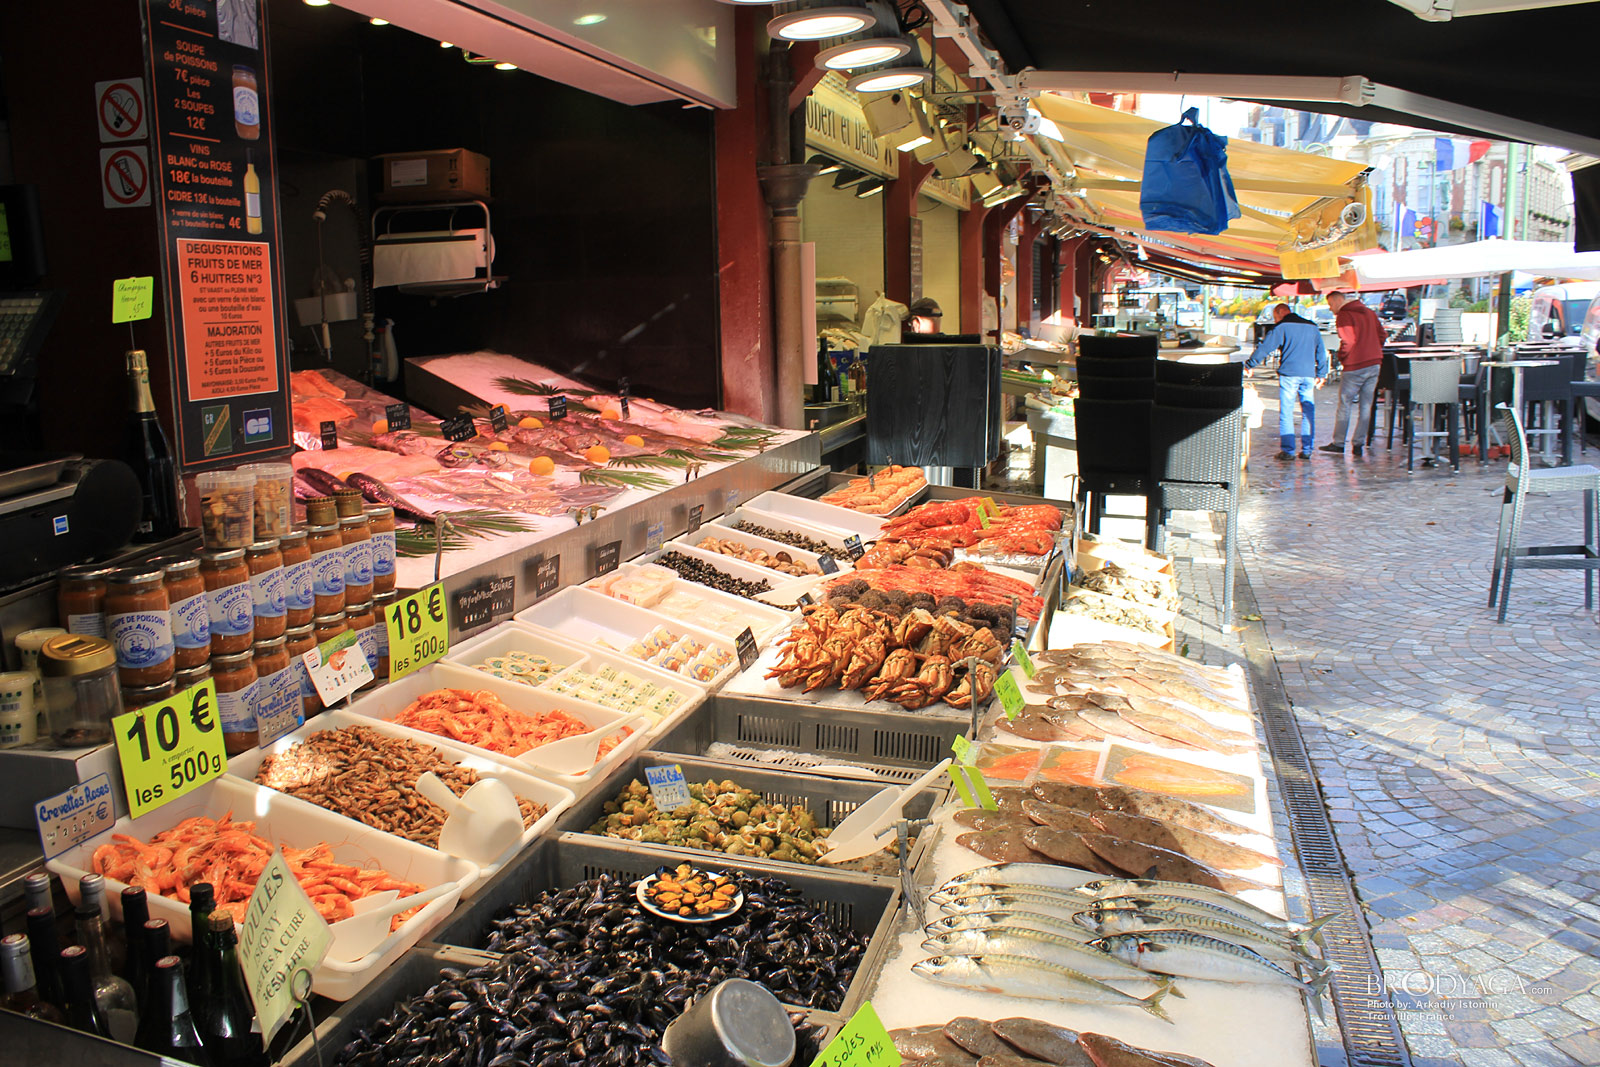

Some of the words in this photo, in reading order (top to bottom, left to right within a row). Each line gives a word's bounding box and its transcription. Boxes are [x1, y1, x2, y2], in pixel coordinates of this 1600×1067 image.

[176, 40, 205, 56] SOUPE
[164, 51, 174, 62] de
[176, 53, 218, 72] POISSONS
[174, 68, 188, 82] 7€
[187, 88, 200, 99] Les
[174, 98, 180, 108] 2
[181, 100, 214, 114] SOUPES
[187, 116, 206, 130] 12€
[806, 96, 836, 140] obert
[840, 116, 850, 146] et
[190, 144, 210, 156] VINS
[168, 154, 198, 168] BLANC
[198, 161, 208, 169] ou
[210, 160, 232, 172] ROSÉ
[170, 170, 190, 184] 18€
[192, 173, 198, 182] la
[200, 174, 232, 186] bouteille
[168, 190, 192, 202] CIDRE
[208, 196, 214, 204] la
[216, 198, 240, 206] bouteille
[228, 216, 241, 229] 4€
[186, 243, 262, 256] DEGUSTATIONS
[188, 258, 225, 269] FRUITS
[227, 259, 240, 269] DE
[242, 260, 262, 270] MER
[190, 270, 199, 283] 6
[201, 273, 244, 283] HUITRES
[246, 274, 262, 284] N°3
[207, 325, 262, 337] MAJORATION
[214, 588, 233, 604] SOUPE
[126, 615, 135, 623] DE
[136, 615, 165, 626] POISSONS
[392, 599, 421, 640] 18
[428, 587, 443, 622] €
[136, 624, 156, 636] Alain
[394, 657, 409, 673] les
[127, 706, 180, 762] 10
[190, 687, 215, 733] €
[168, 746, 195, 763] emporter
[40, 794, 84, 822] Crevettes
[84, 784, 109, 803] Roses
[136, 784, 163, 807] les
[280, 908, 306, 948] CUIRE
